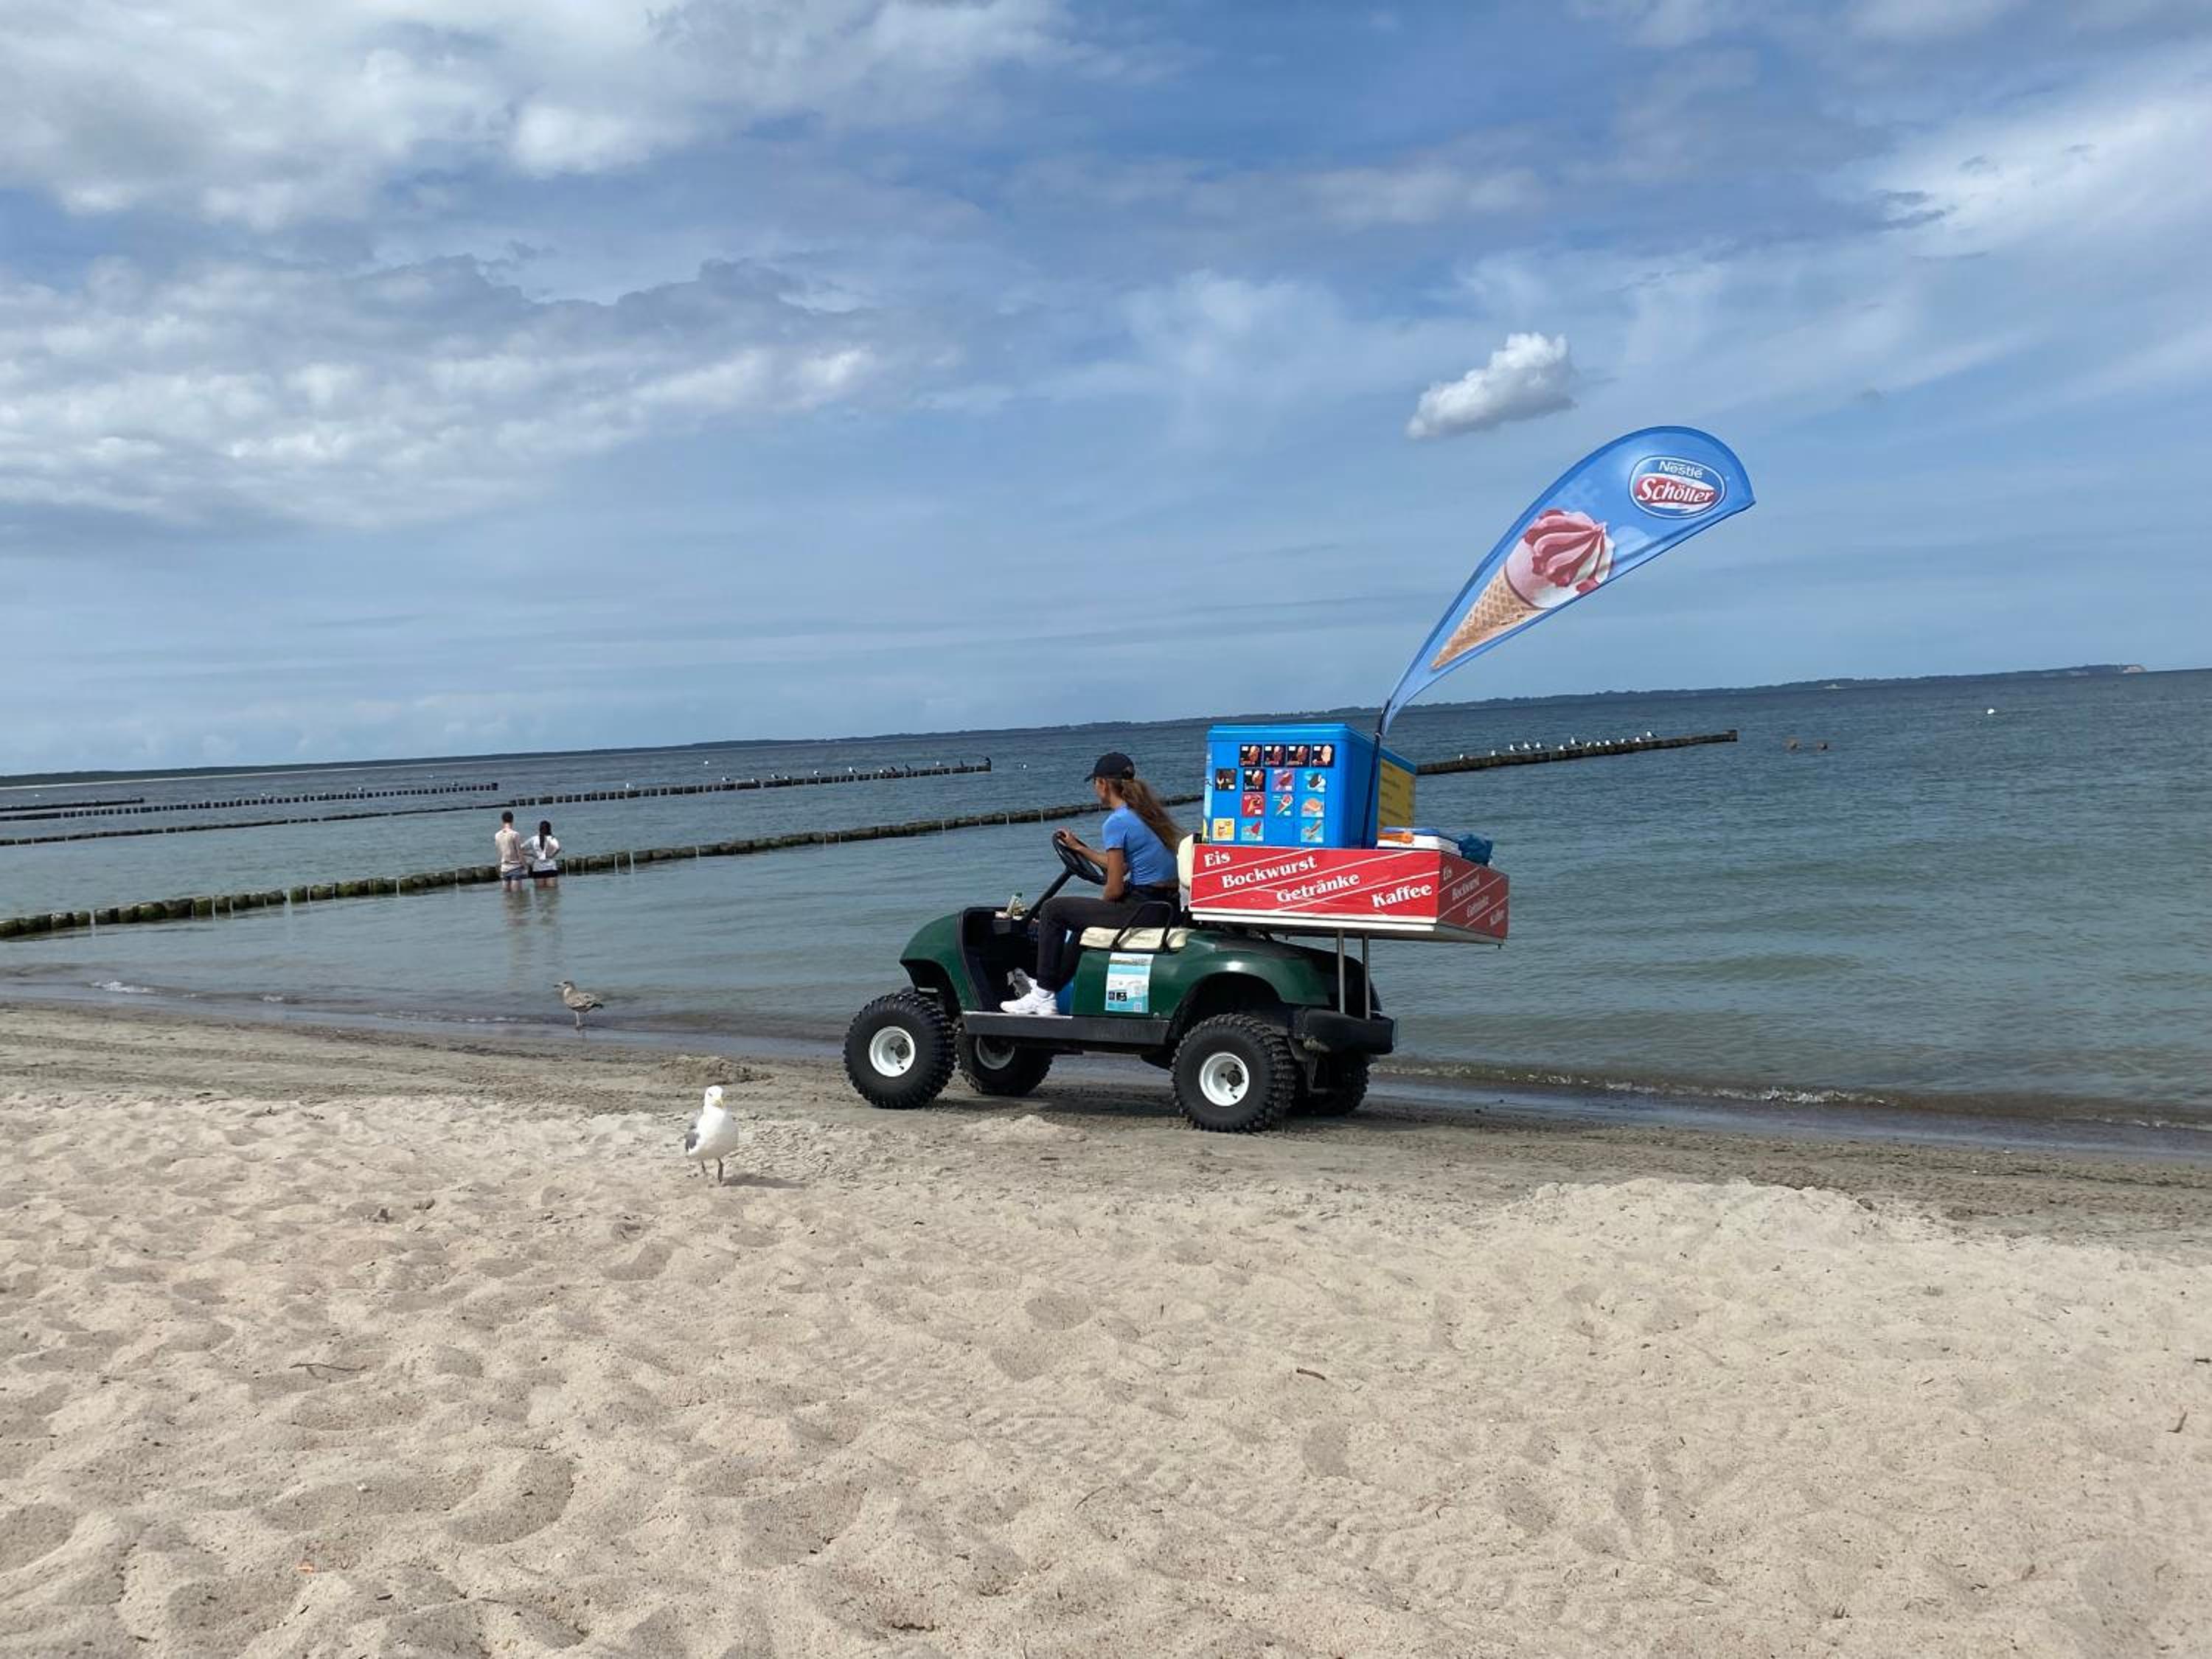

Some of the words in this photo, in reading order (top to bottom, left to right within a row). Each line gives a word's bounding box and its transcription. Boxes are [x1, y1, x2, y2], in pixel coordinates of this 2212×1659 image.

[1638, 478, 1714, 503] Schöller
[1204, 851, 1231, 867] Eis
[1222, 855, 1318, 888] Bockwurst
[1276, 874, 1360, 902] Getränke
[1371, 885, 1433, 908] Kaffee
